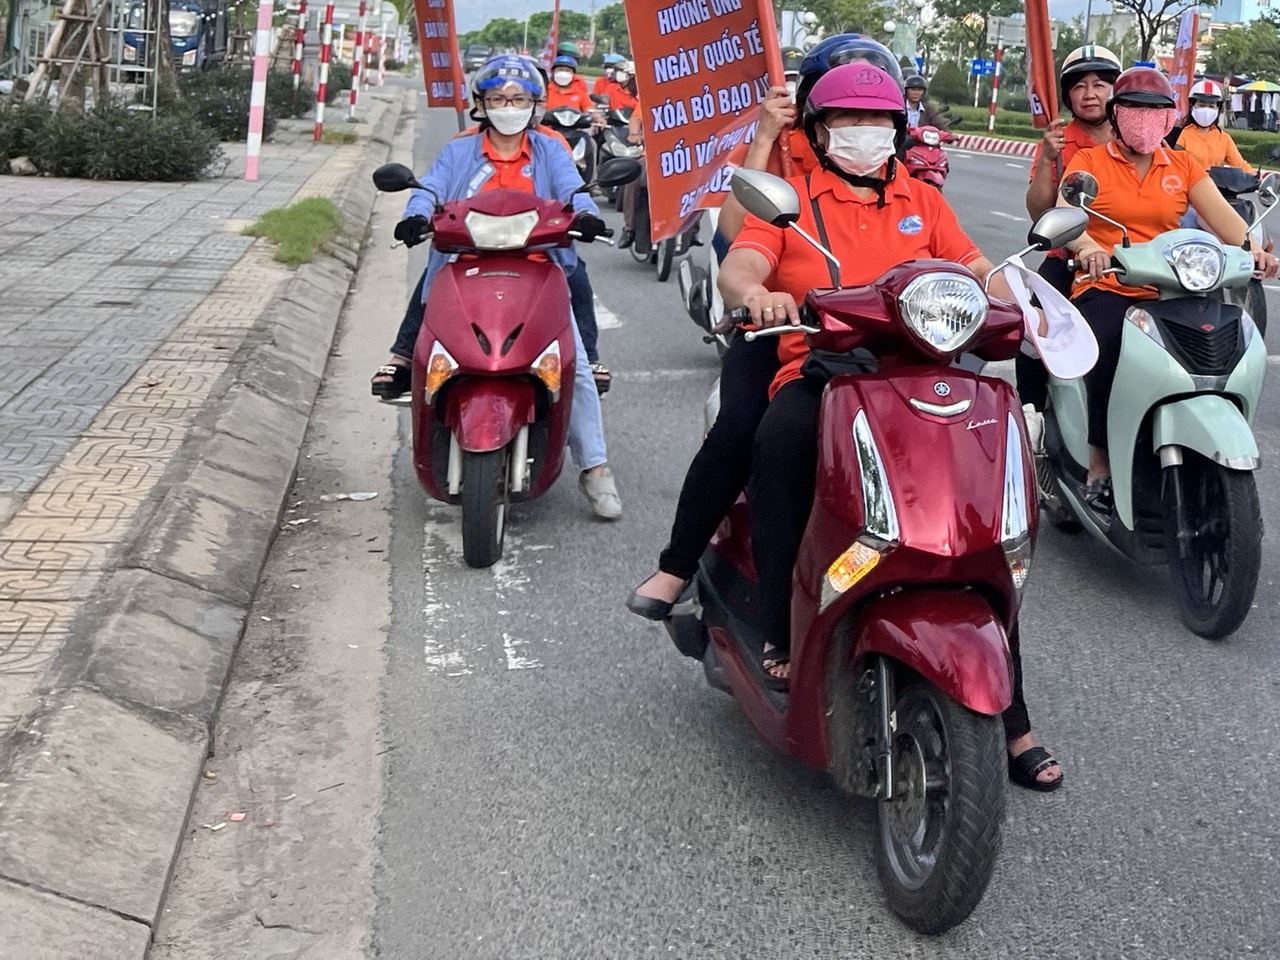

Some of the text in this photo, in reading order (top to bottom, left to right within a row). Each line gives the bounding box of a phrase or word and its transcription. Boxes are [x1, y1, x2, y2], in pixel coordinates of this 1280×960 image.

[653, 19, 764, 84] NGÀY QUỐC TẾ
[651, 98, 689, 133] XÓA
[690, 84, 715, 122] BỎ
[718, 82, 752, 117] BẠO
[661, 139, 692, 178] ĐỐI
